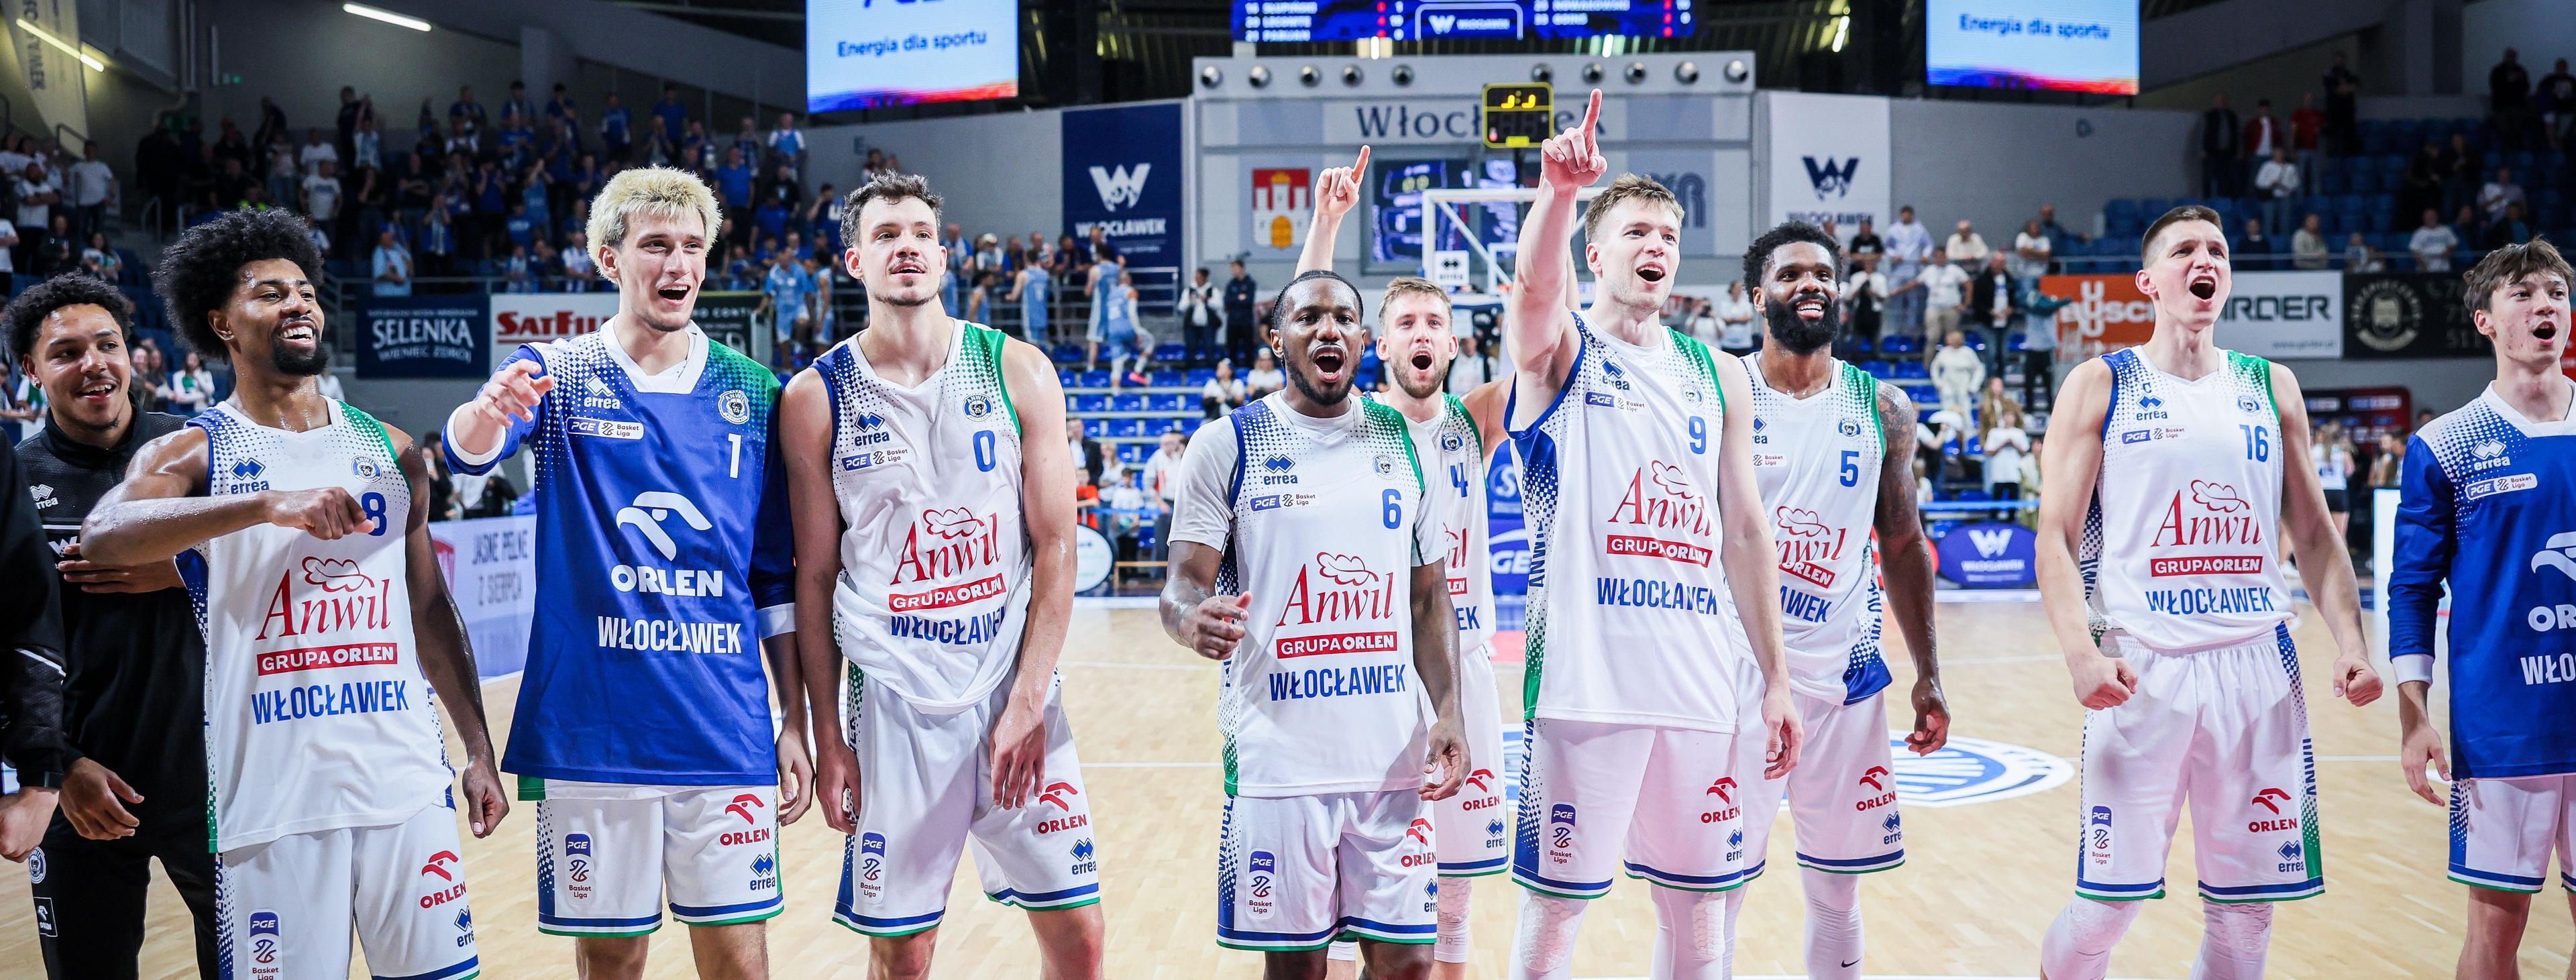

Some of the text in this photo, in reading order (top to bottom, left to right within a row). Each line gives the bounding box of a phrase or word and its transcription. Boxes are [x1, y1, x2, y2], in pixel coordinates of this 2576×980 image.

[1959, 13, 2110, 39] Energia dla sportu
[837, 30, 987, 58] Energia dla sportu
[373, 319, 474, 349] SELENKA
[2143, 382, 2152, 394] C
[584, 397, 620, 410] errea
[1589, 394, 1612, 404] PGE
[2136, 410, 2168, 421] errea
[571, 421, 596, 431] PGE
[854, 431, 890, 446] errea
[1688, 415, 1706, 455] 9
[2125, 432, 2147, 443] PGE
[2239, 424, 2269, 463] 16
[727, 433, 742, 479] 1
[973, 430, 996, 472] 0
[846, 456, 867, 469] PGE
[1839, 450, 1860, 488] 5
[2473, 456, 2511, 471] errea
[230, 480, 270, 494] errea
[1263, 474, 1299, 486] errea
[1450, 462, 1468, 498] 4
[2471, 483, 2491, 496] PGE
[36, 497, 58, 510] rrea
[1254, 498, 1276, 508] PGE
[1382, 488, 1402, 530] 6
[361, 492, 387, 537] 8
[2150, 489, 2263, 547] Anwil
[890, 512, 1001, 586] Anwil
[1776, 528, 1847, 563] nwil
[1491, 550, 1532, 574] GE
[611, 564, 723, 597] ORLEN
[1276, 563, 1395, 627] Anwil
[1597, 577, 1717, 616] WŁOCŁAWEK
[2145, 587, 2275, 615] WŁOCŁAWEK
[255, 569, 391, 641] Anwil
[597, 616, 741, 654] WŁOCŁAWEK
[2520, 653, 2576, 685] WŁO
[1269, 663, 1407, 702] WŁOCŁAWEK
[252, 680, 409, 725] WŁOCŁAWEK
[1462, 796, 1501, 812] ORLEN
[1856, 791, 1896, 811] ORLEN
[1553, 810, 1574, 820] PGE
[1701, 806, 1741, 824] ORLEN
[2092, 812, 2110, 821] PGE
[1037, 814, 1087, 834] ORLEN
[2248, 818, 2298, 833] ORLEN
[568, 841, 588, 849] PGE
[720, 828, 770, 846] ORLEN
[863, 838, 883, 849] PGE
[1252, 858, 1273, 867] PGE
[1550, 850, 1572, 859] Basket
[2095, 857, 2107, 865] Liga
[1071, 861, 1097, 875] errea
[2278, 861, 2304, 873] errea
[750, 877, 775, 891] errea
[860, 882, 881, 891] Basket
[420, 881, 466, 909] ORLEN
[863, 890, 877, 898] Liga
[252, 920, 276, 928] PGE
